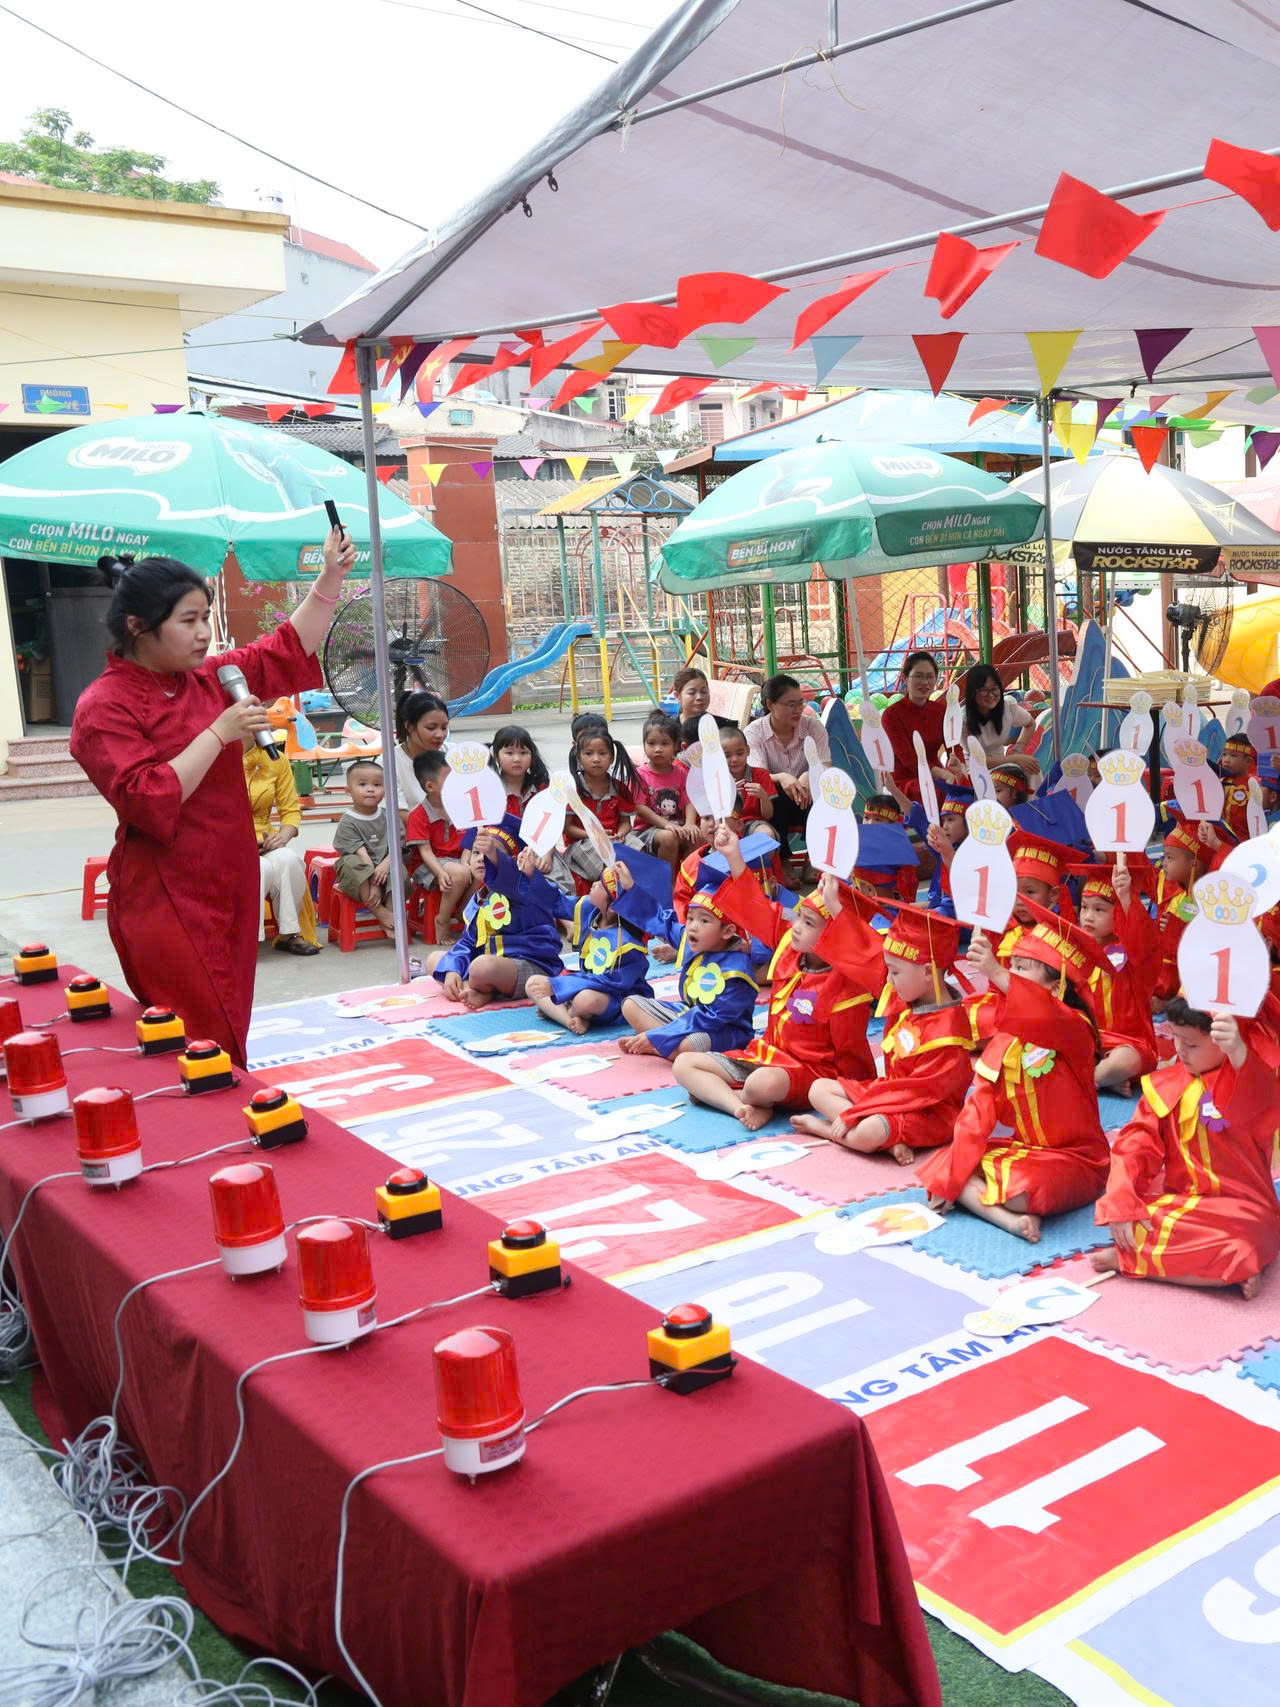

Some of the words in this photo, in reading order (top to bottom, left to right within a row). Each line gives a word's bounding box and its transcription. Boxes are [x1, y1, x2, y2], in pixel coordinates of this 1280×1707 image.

[88, 444, 176, 463] MILO
[29, 523, 64, 537] CHỌN
[67, 522, 115, 542] MILO
[116, 533, 149, 546] NGAY
[944, 513, 971, 530] MILO
[971, 516, 991, 526] NGAY
[9, 538, 32, 549] CON
[1098, 546, 1134, 556] NƯỚC
[1169, 548, 1192, 557] LỰC
[950, 717, 956, 741] 1
[1131, 724, 1141, 749] 1
[1186, 713, 1193, 735] 1
[1264, 726, 1279, 749] 1
[873, 738, 884, 766] 1
[464, 786, 486, 822] 1
[1192, 779, 1209, 814] 1
[530, 811, 551, 843] 1
[1111, 802, 1129, 843] 1
[823, 825, 837, 868] 1
[975, 866, 992, 918] 1
[903, 945, 920, 961] ABC
[1211, 947, 1235, 1006] 1
[531, 1152, 604, 1174] TÂM
[616, 1138, 664, 1157] AN
[1025, 1286, 1081, 1311] 2
[898, 1340, 993, 1385] TÂM
[895, 1396, 1166, 1533] 11
